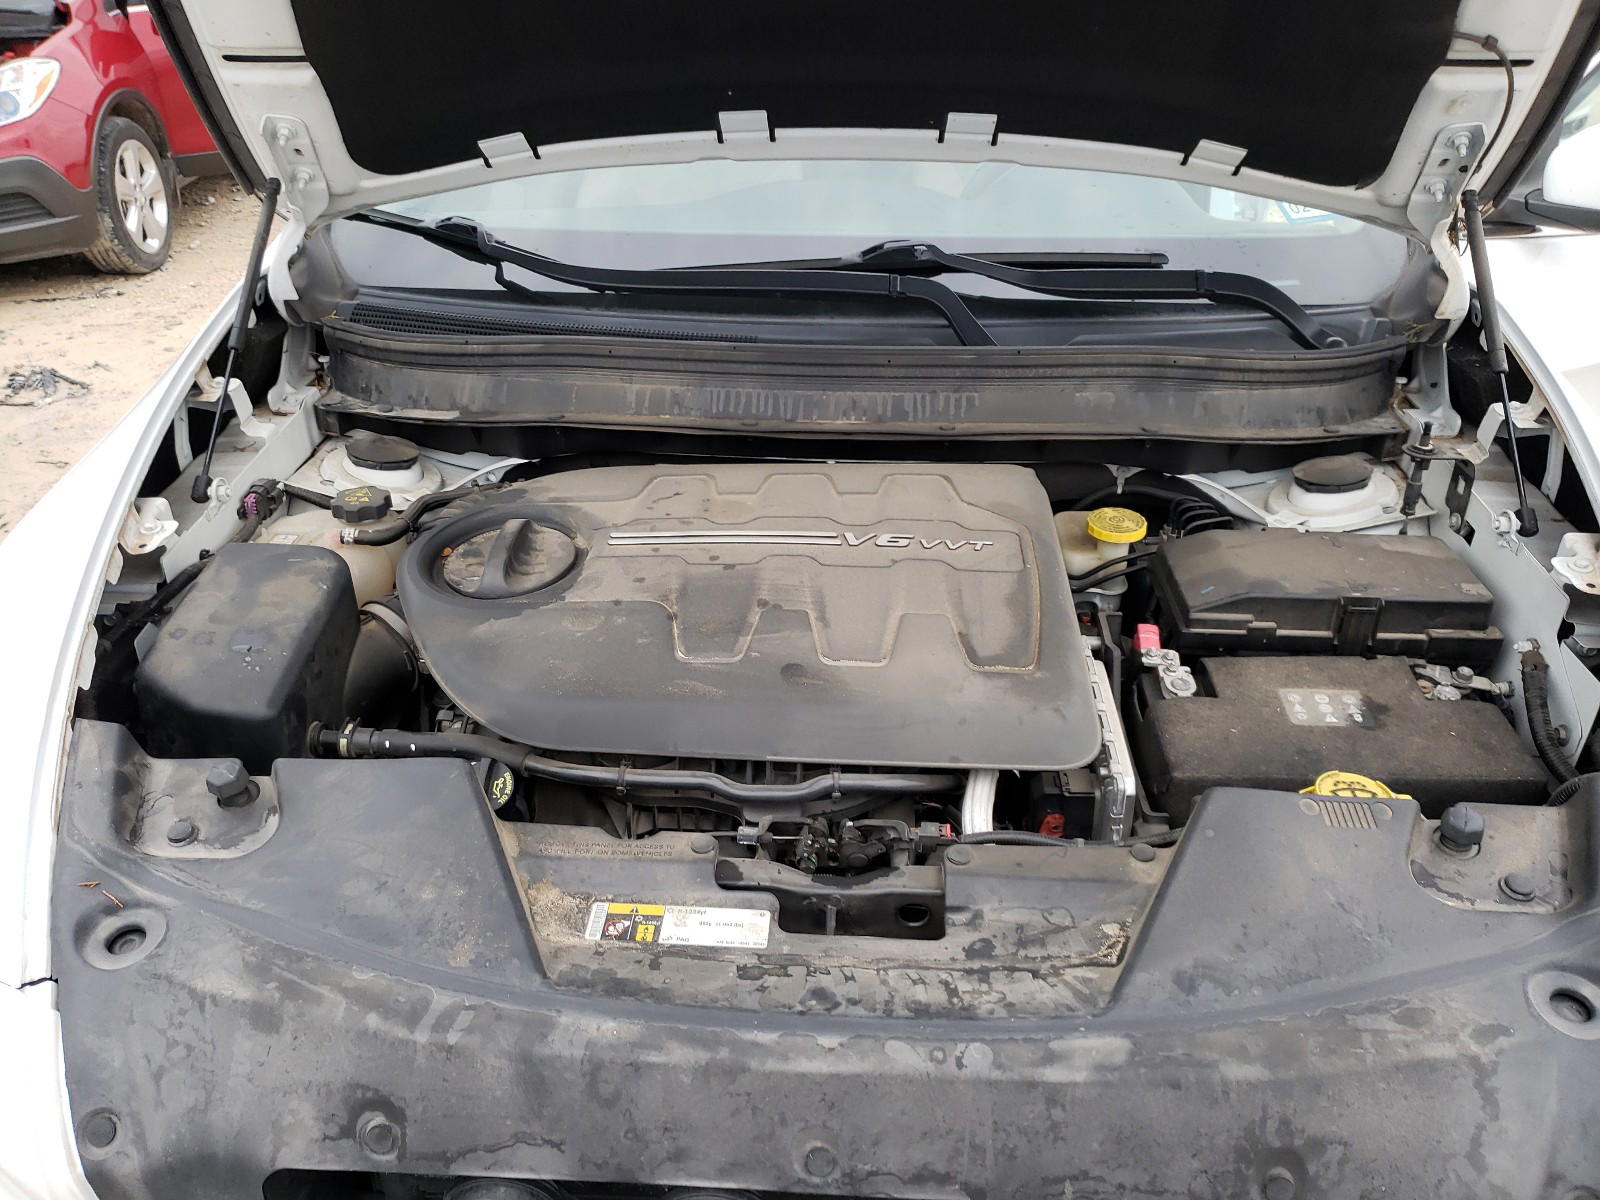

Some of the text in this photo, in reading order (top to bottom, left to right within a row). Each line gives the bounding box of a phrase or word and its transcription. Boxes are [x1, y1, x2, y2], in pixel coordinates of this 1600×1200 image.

[844, 532, 993, 551] V6 VVT
[498, 772, 512, 804] ENGINE OIL
[590, 842, 615, 850] PANEL
[634, 843, 665, 851] ACCESS
